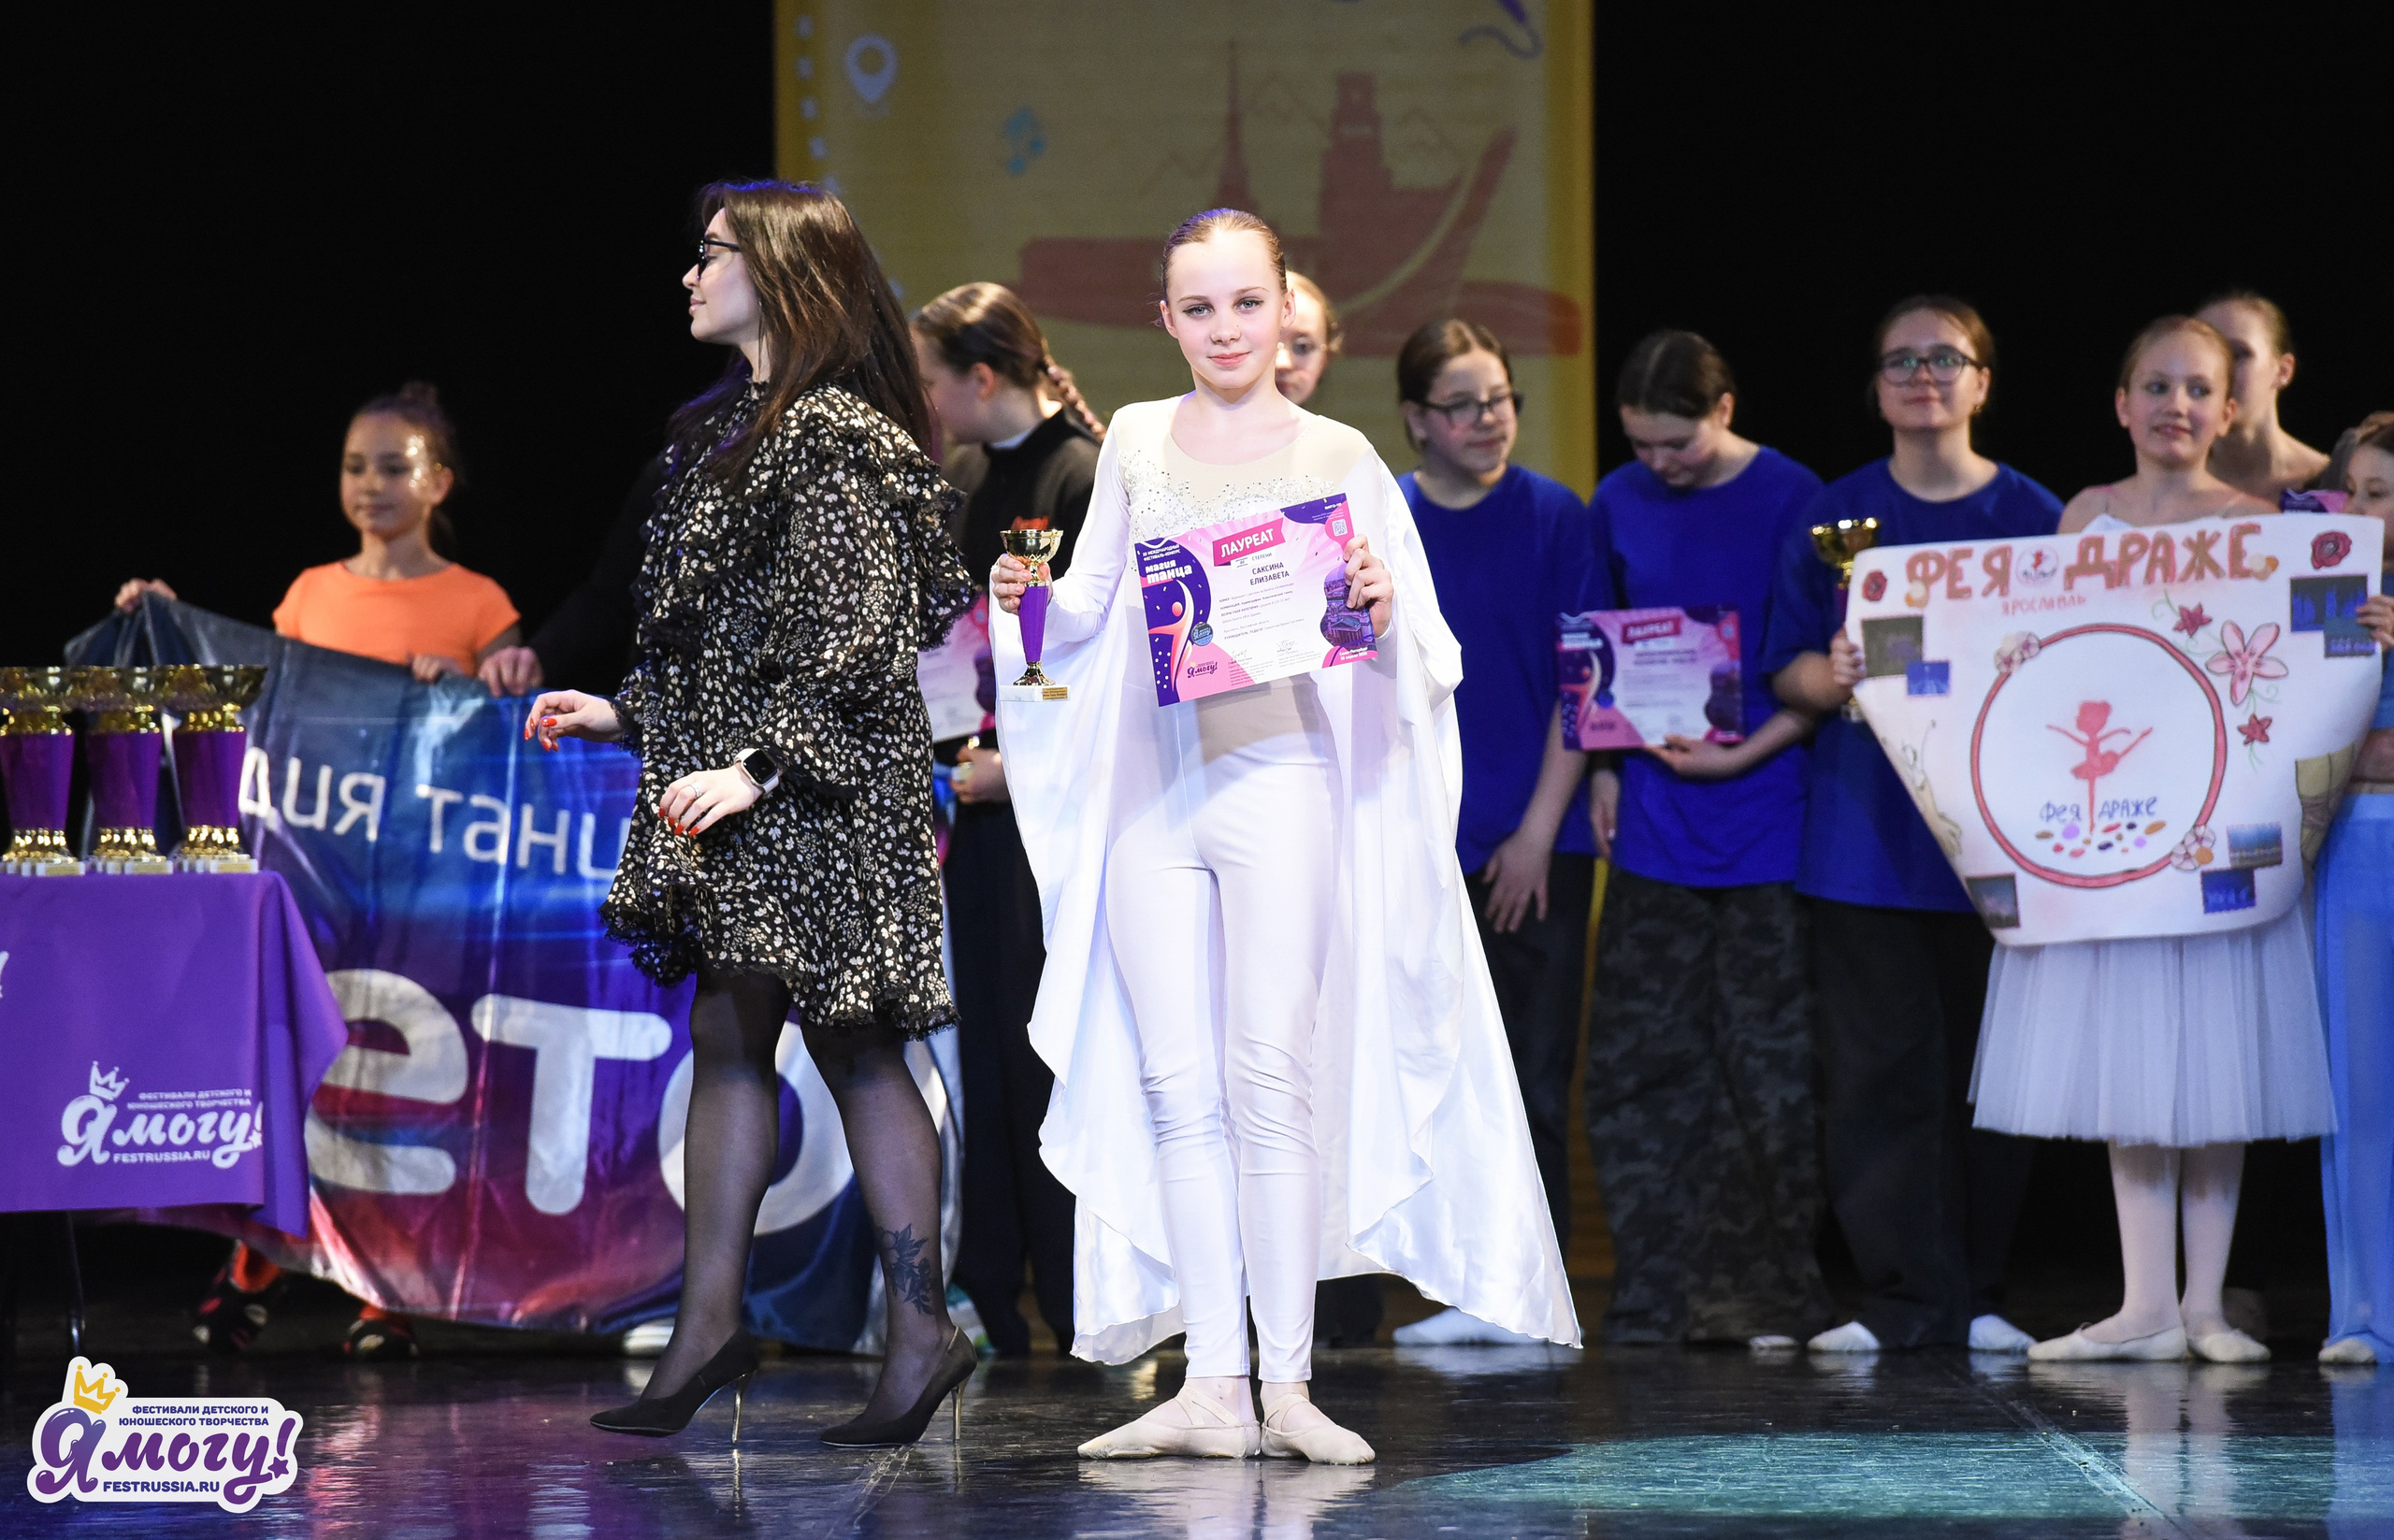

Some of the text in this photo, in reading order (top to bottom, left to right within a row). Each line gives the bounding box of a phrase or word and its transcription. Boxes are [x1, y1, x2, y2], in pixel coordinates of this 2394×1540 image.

[1220, 528, 1274, 558] ЛАУРЕАТ
[1145, 559, 1176, 574] магия
[1251, 561, 1284, 575] САКСИНА
[1905, 522, 2262, 604] ФЕЯ ДРАЖЕ
[1147, 565, 1193, 584] танца
[1249, 570, 1290, 586] ЕЛИЗАВЕТА
[113, 1149, 210, 1163] FESTRUSSIA.RU
